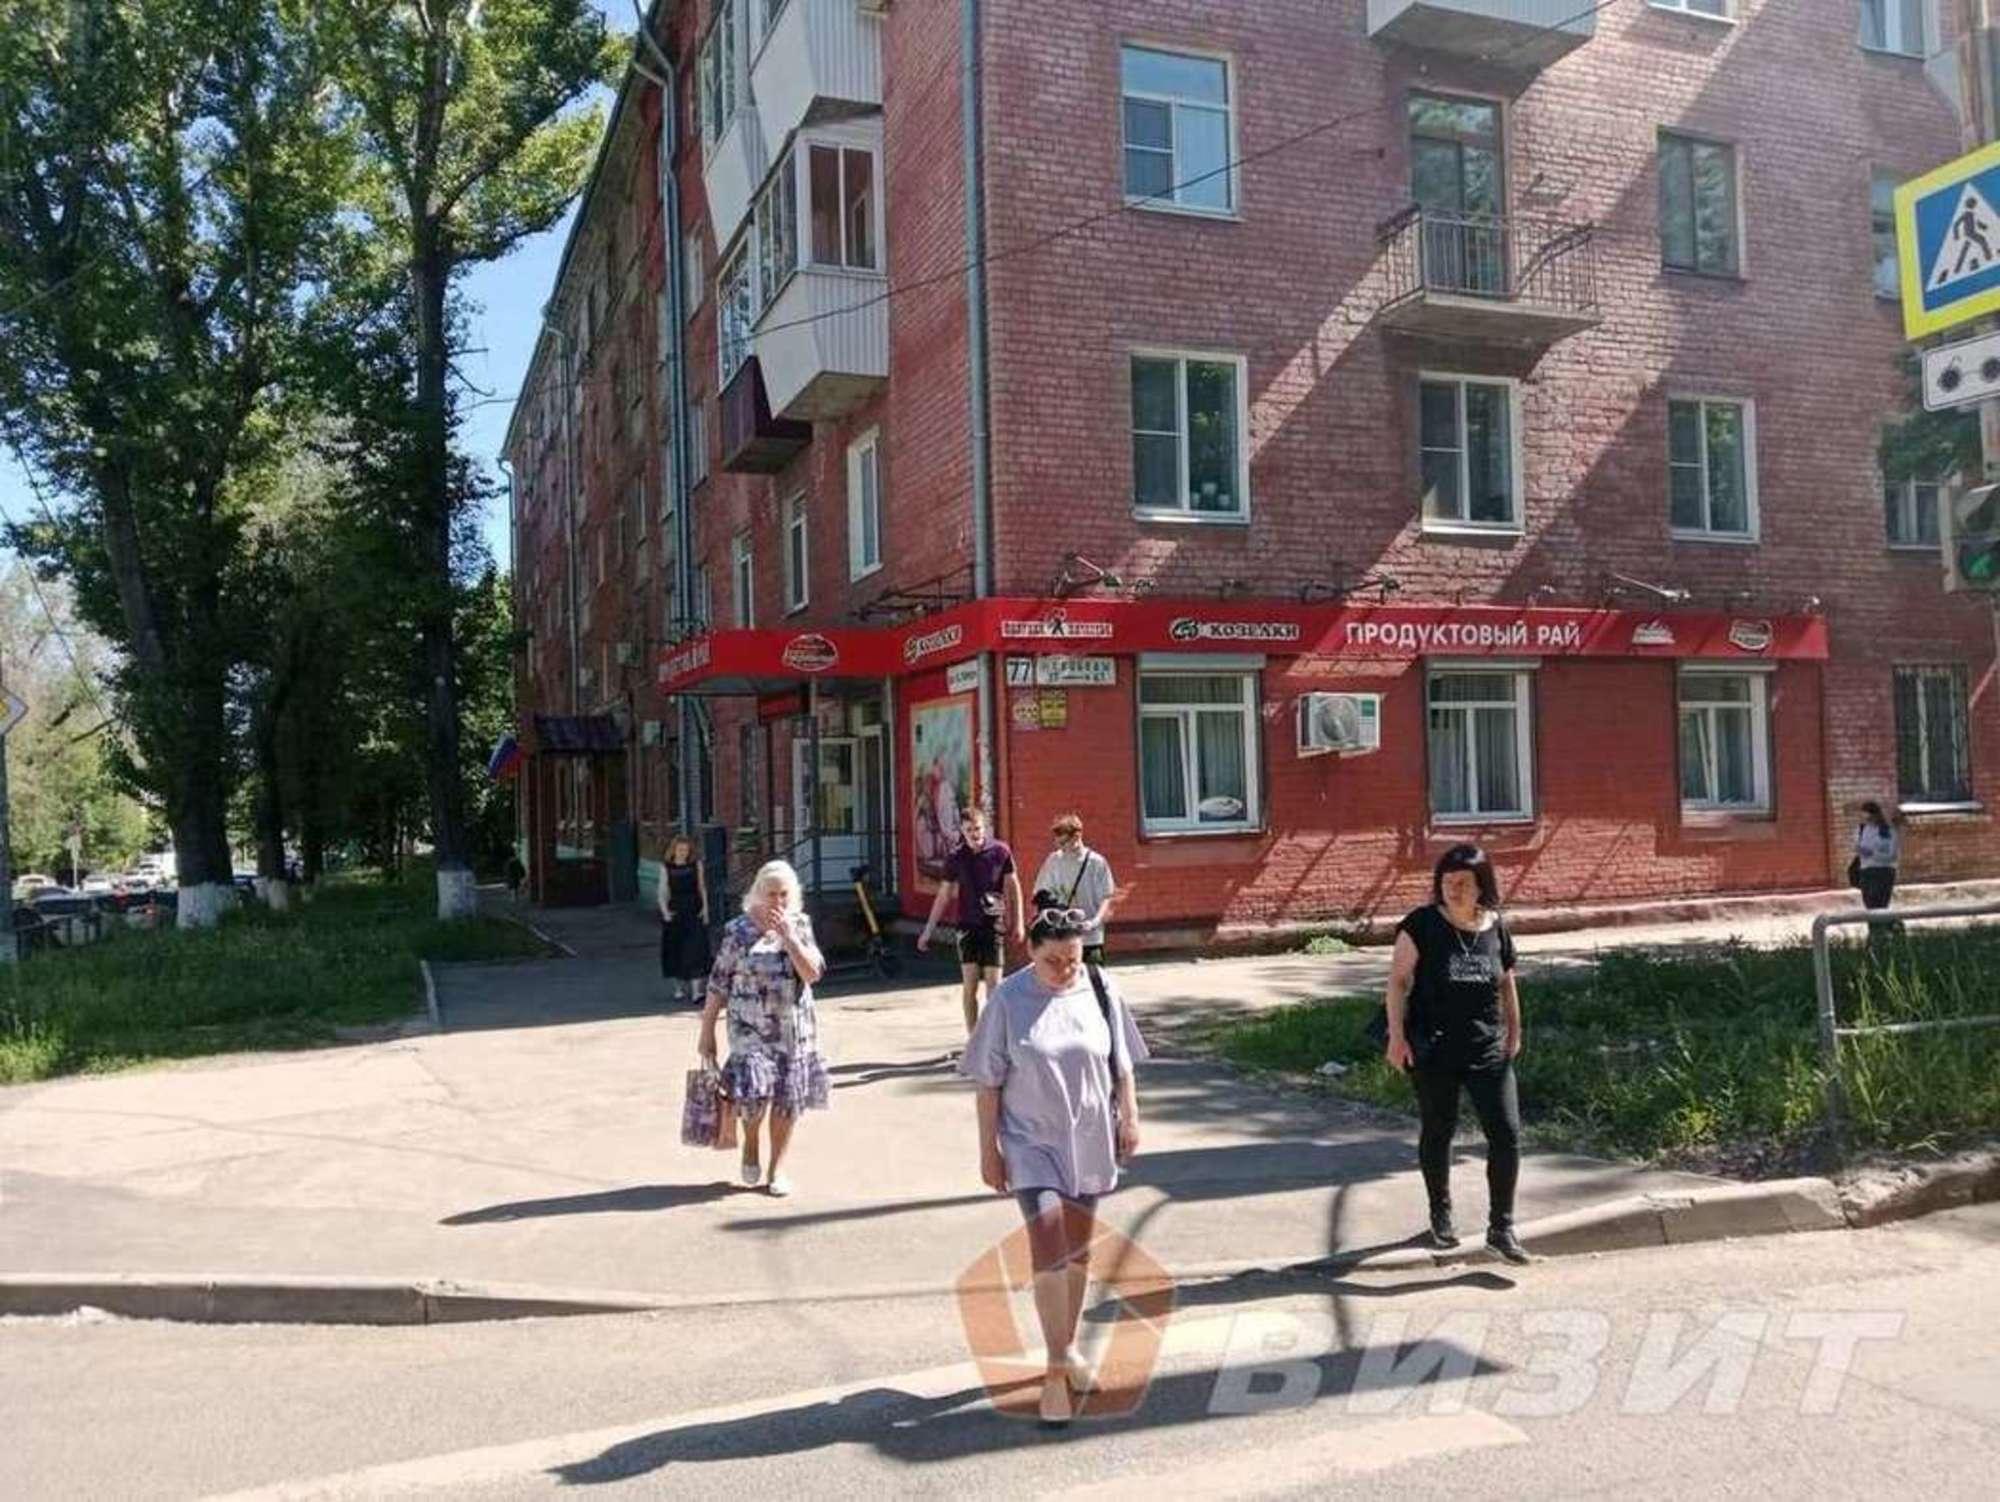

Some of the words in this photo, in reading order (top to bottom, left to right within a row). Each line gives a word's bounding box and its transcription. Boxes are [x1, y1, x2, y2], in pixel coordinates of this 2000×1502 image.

[1347, 620, 1527, 648] ПРОДУКТОВЫЙ
[1537, 621, 1581, 646] РАЙ
[1008, 660, 1031, 682] 77
